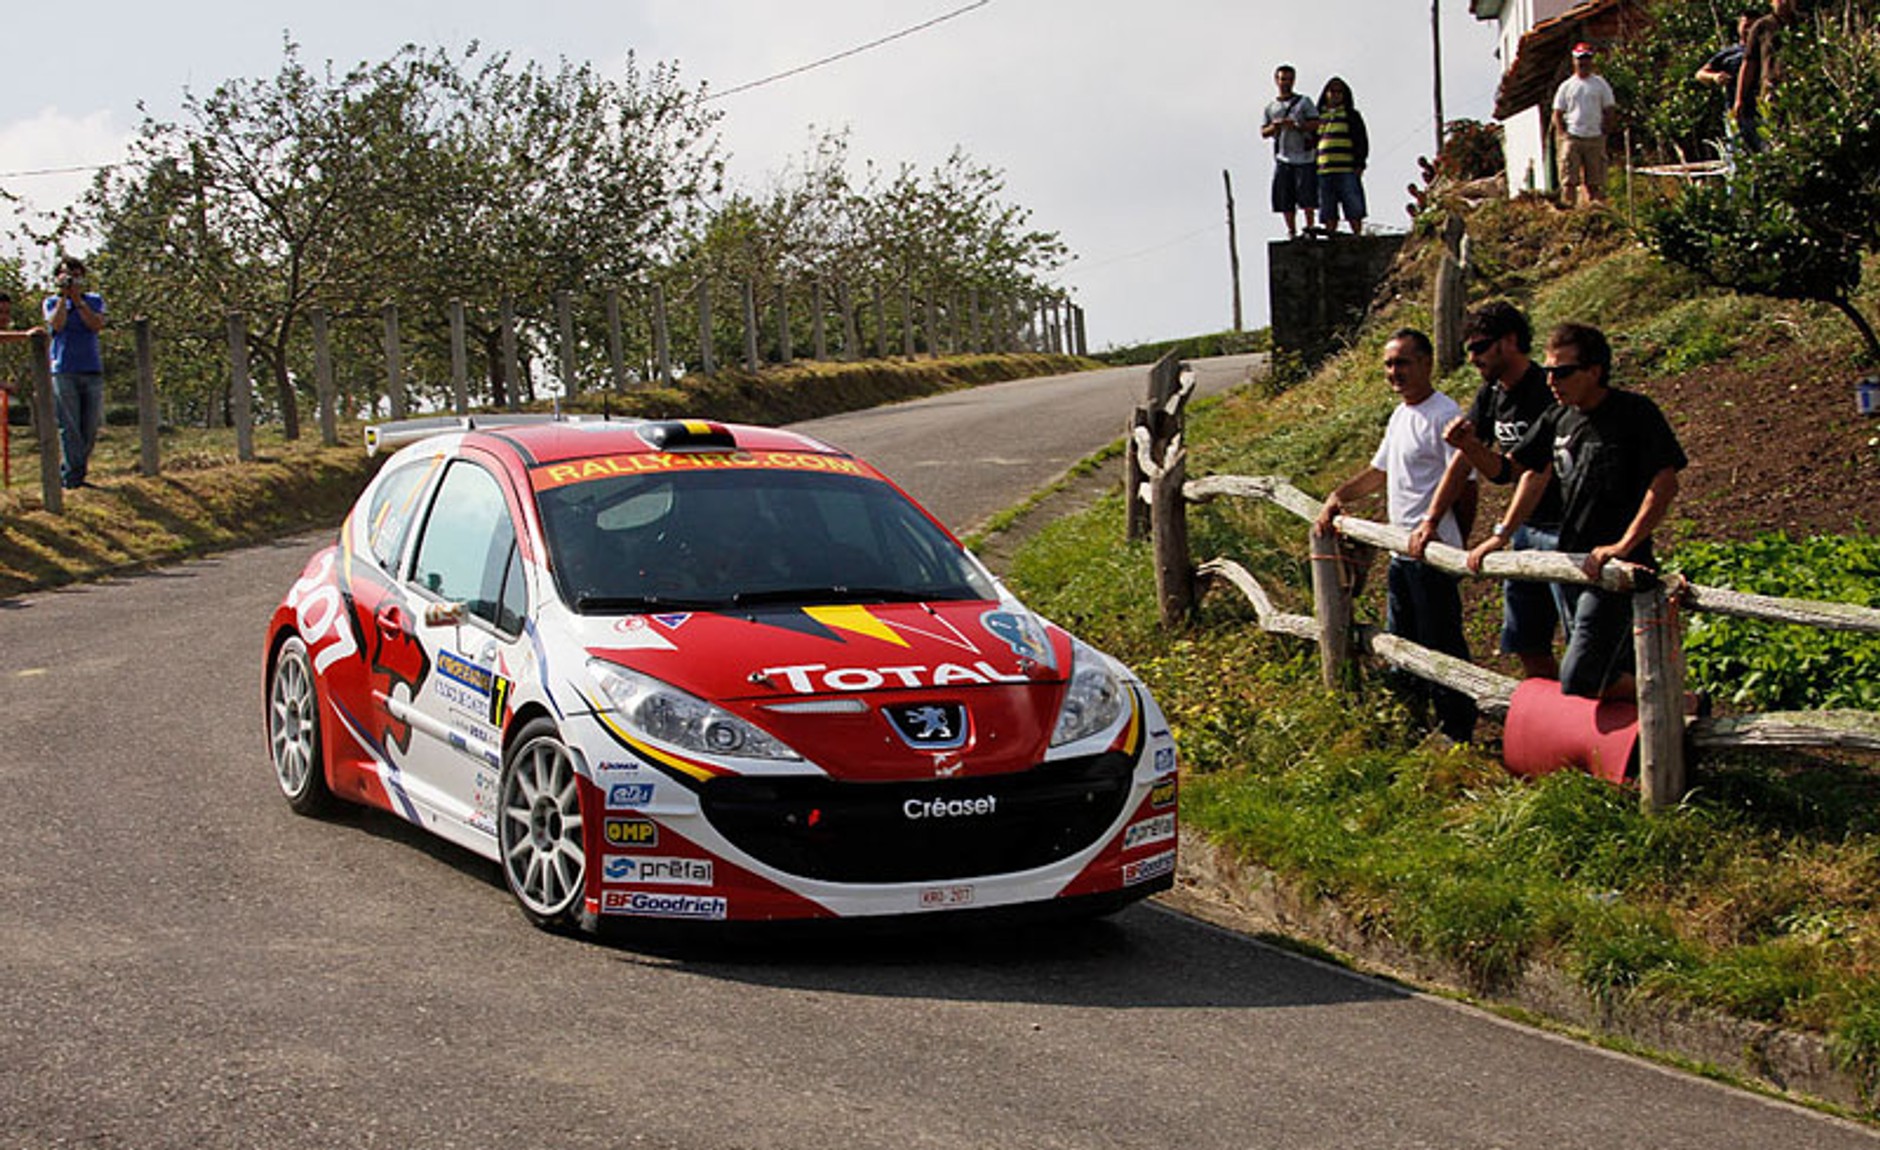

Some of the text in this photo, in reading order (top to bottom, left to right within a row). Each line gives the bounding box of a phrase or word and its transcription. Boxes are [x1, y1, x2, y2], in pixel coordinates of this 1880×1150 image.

[287, 551, 358, 676] 207
[764, 661, 1029, 694] TOTAL
[903, 795, 997, 819] Créaset
[607, 823, 653, 841] OMP
[605, 893, 725, 912] BFGoodrich
